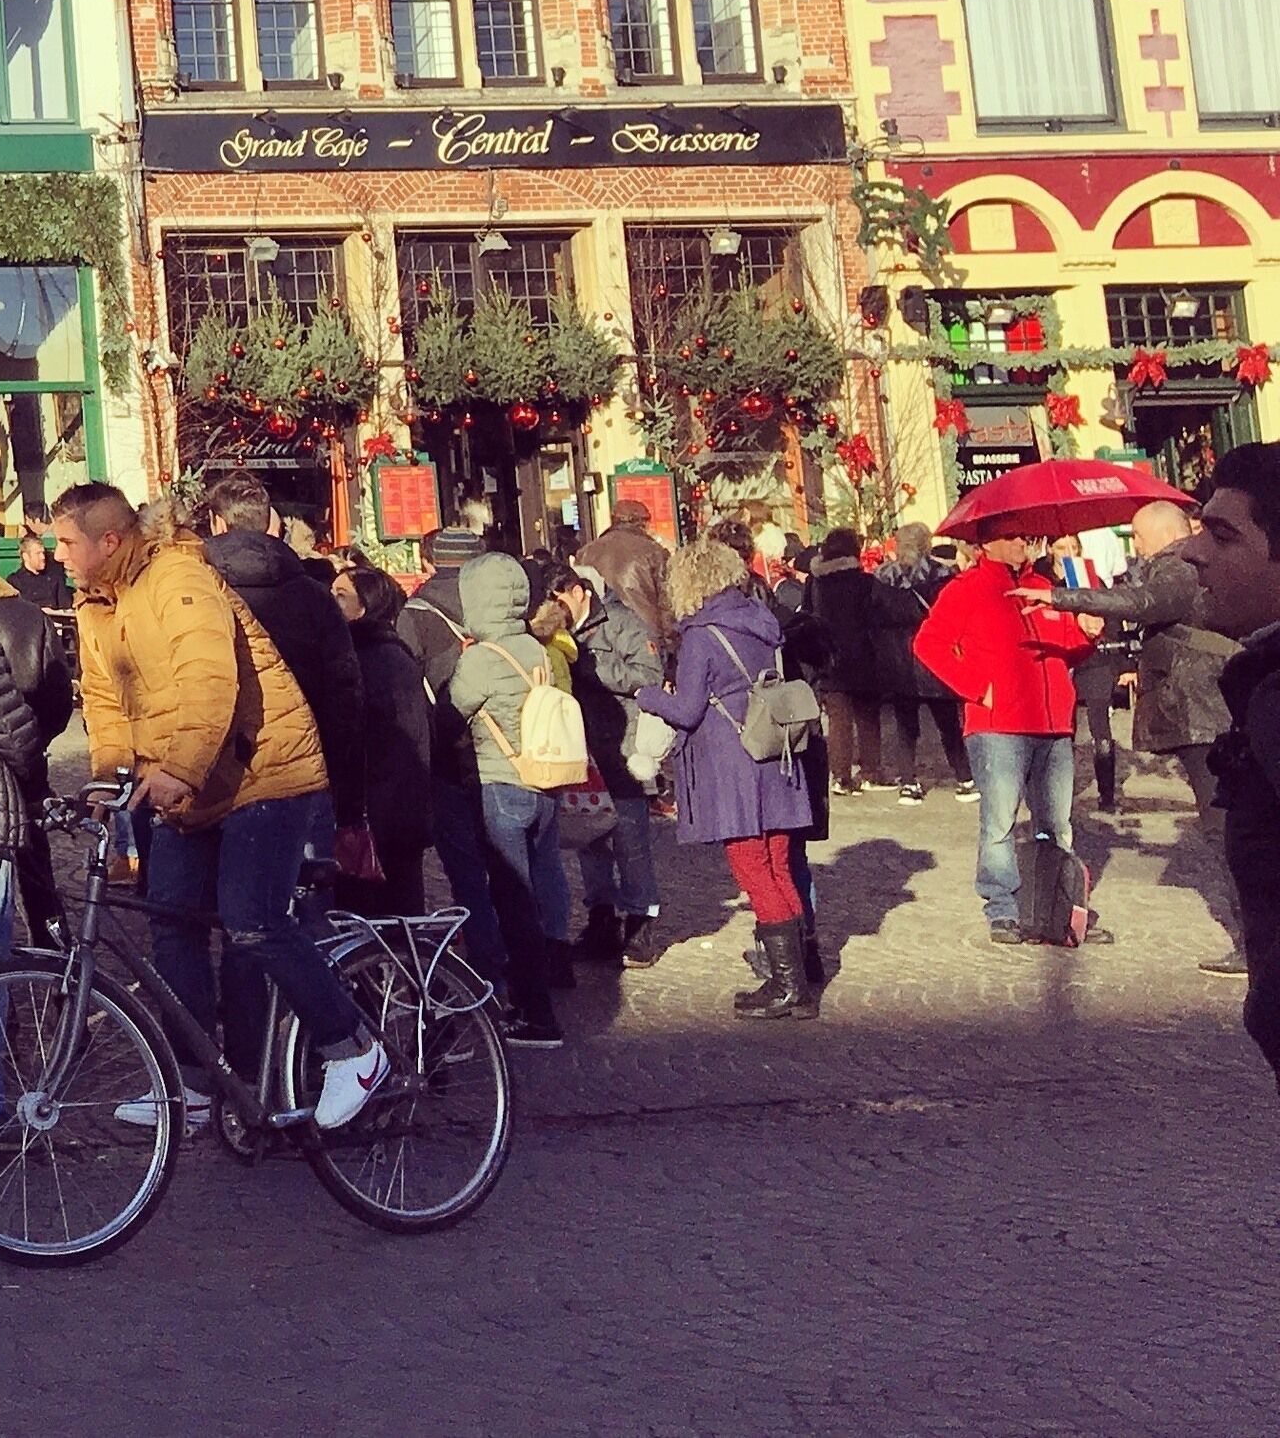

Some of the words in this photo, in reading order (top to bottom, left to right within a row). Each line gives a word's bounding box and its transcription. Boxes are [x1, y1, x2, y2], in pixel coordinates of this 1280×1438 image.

[220, 129, 309, 167] Grand
[432, 113, 554, 164] Central
[611, 123, 761, 154] Brasserie
